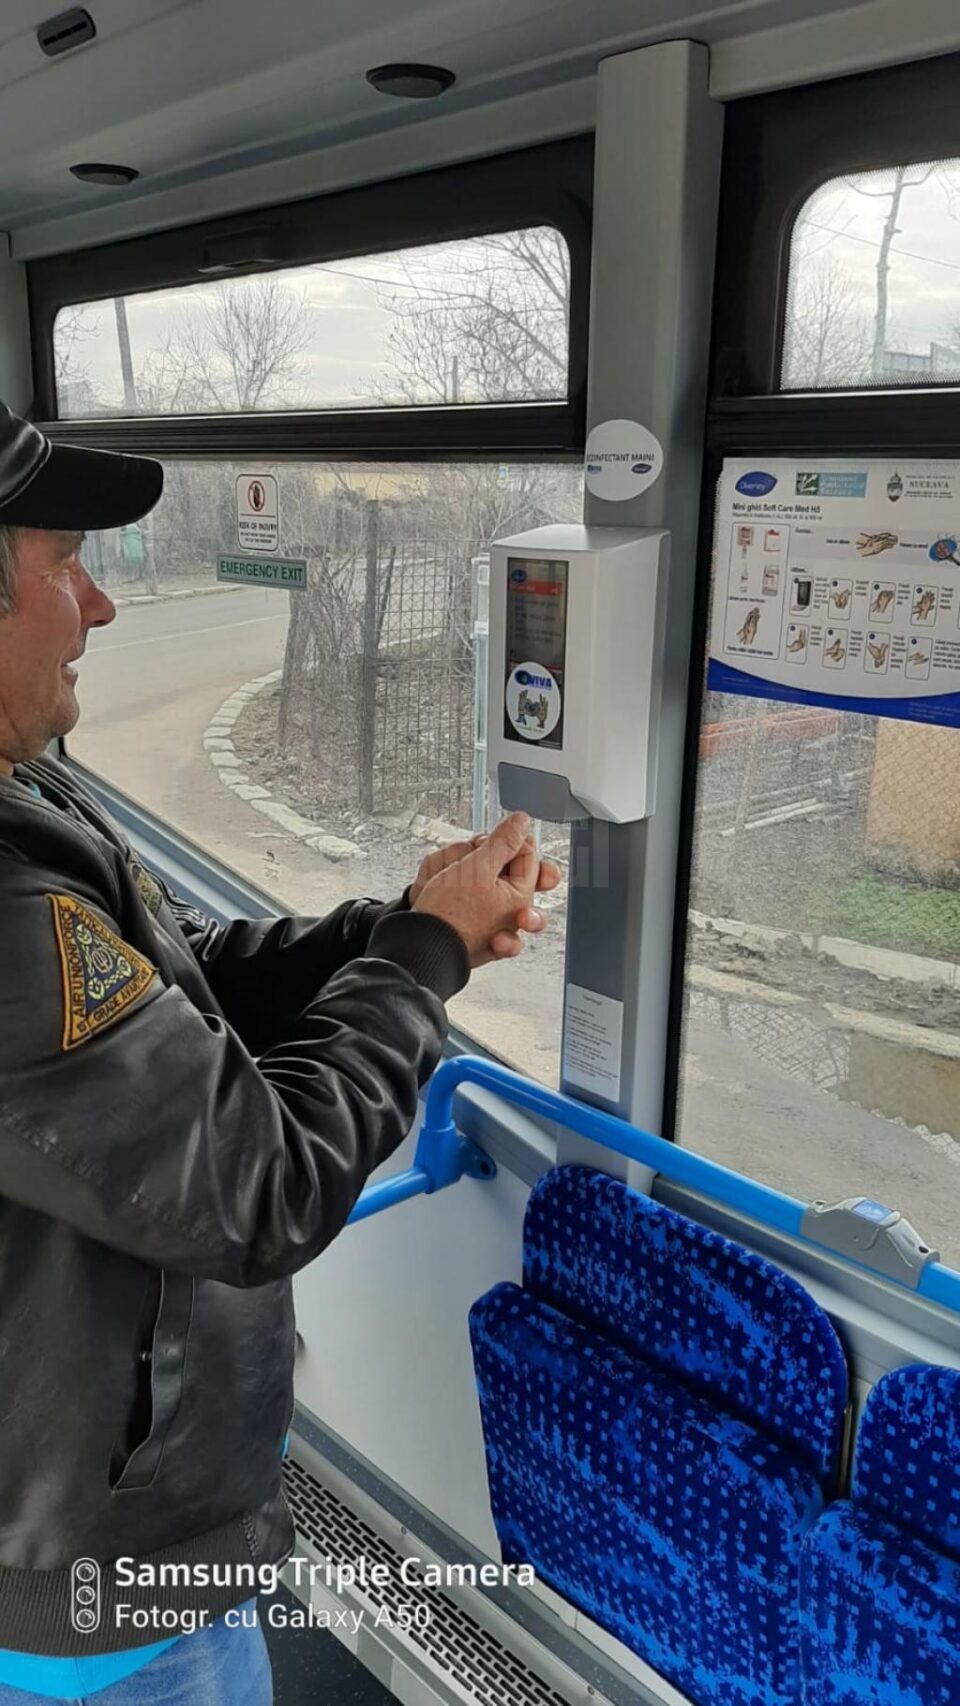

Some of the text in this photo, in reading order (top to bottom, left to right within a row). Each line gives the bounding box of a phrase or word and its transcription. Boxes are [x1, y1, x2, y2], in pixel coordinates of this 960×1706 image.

[910, 480, 950, 489] SUCEAVA
[778, 504, 793, 512] Care
[220, 560, 303, 581] EMERGENCY EXIT
